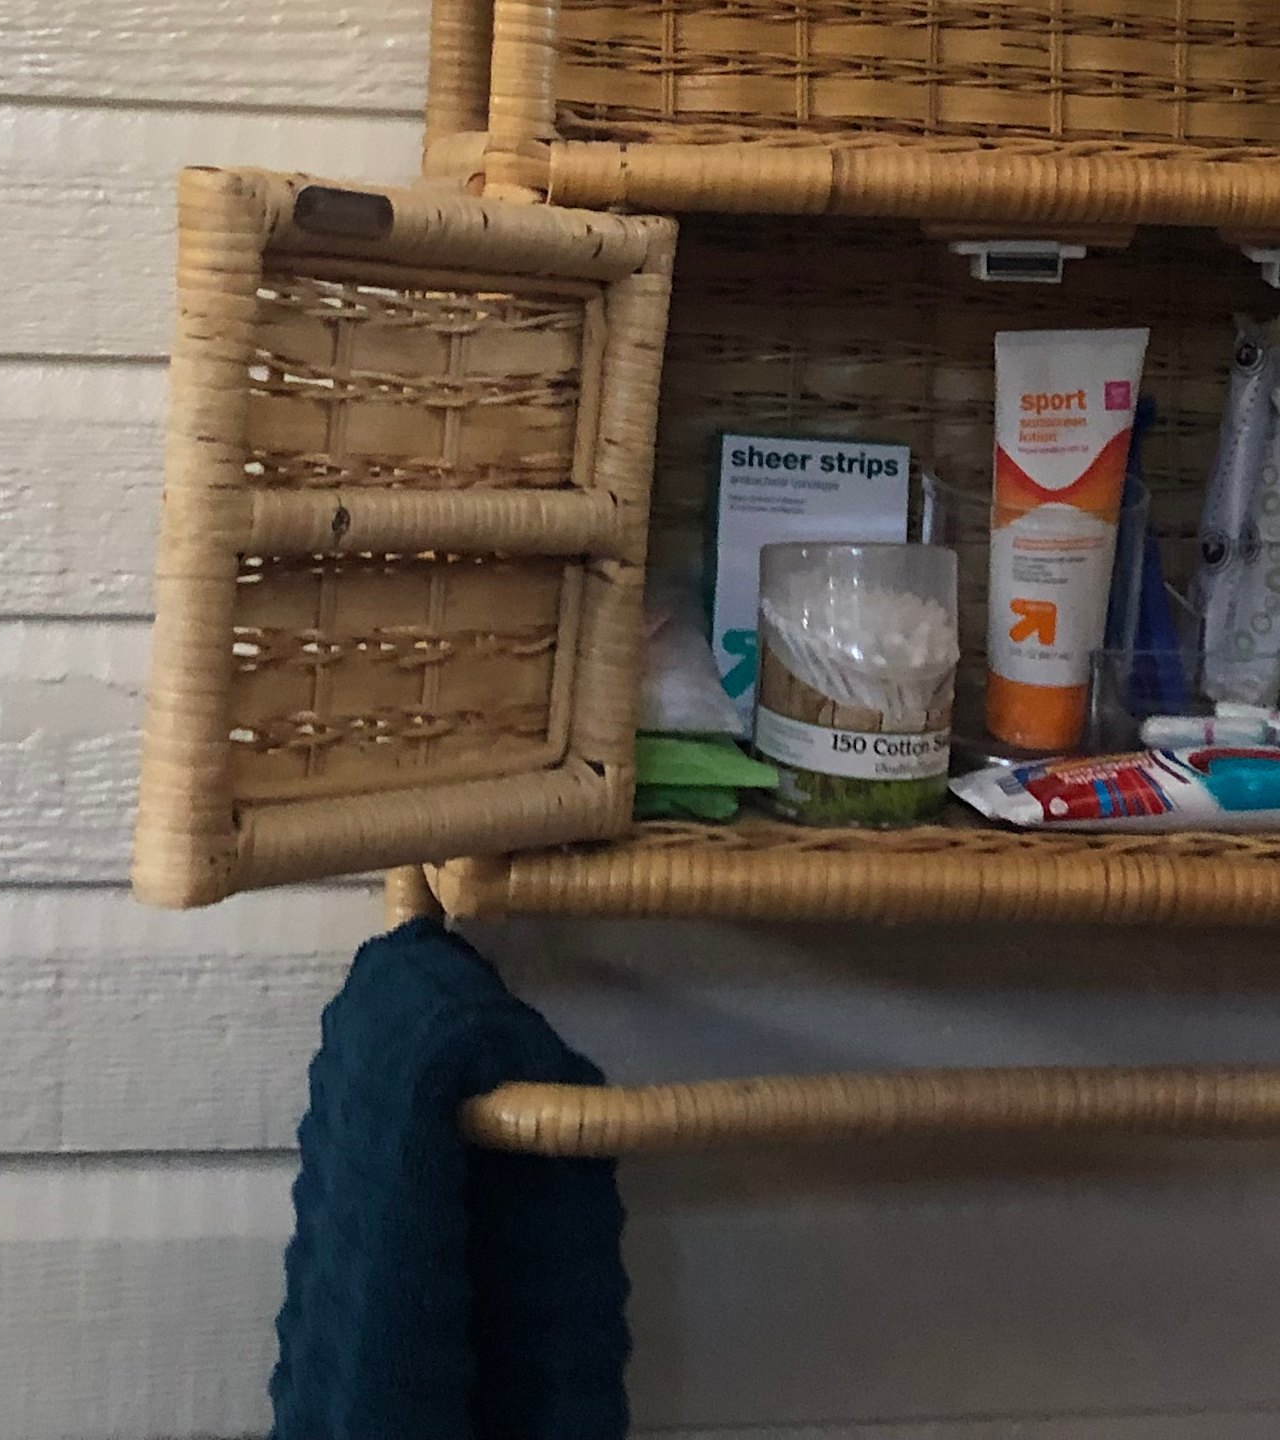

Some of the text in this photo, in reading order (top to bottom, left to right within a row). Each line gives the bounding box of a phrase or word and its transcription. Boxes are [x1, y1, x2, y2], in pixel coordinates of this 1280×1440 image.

[1019, 389, 1087, 415] sport
[1019, 430, 1058, 443] lotion
[731, 445, 899, 480] sheer strips
[831, 732, 868, 755] 150
[872, 736, 930, 757] Cotton
